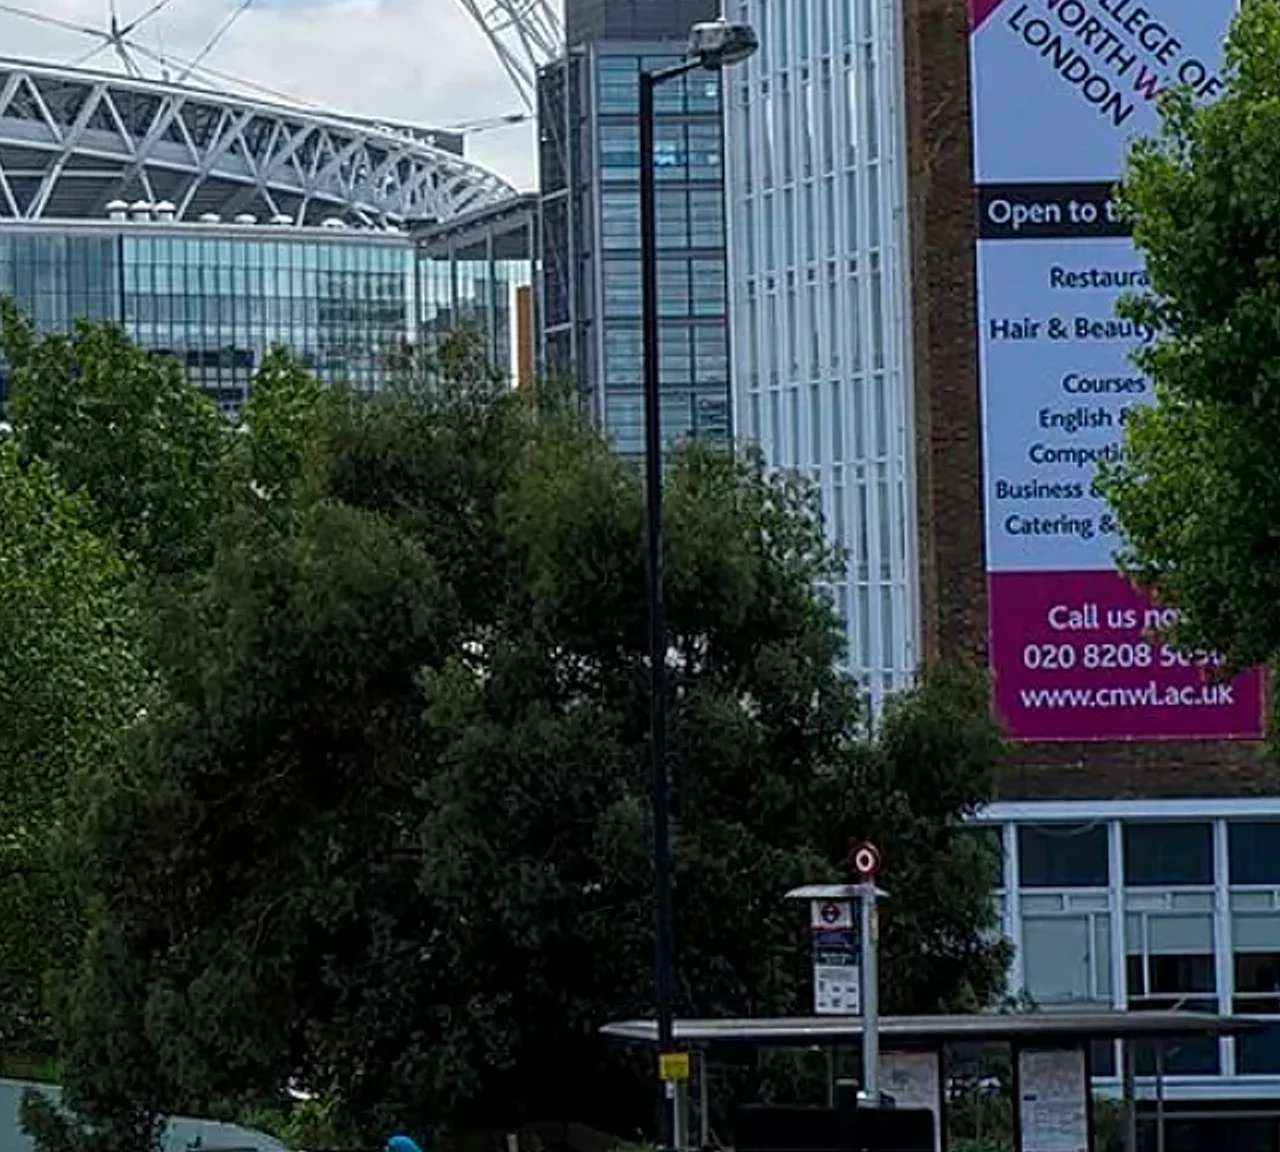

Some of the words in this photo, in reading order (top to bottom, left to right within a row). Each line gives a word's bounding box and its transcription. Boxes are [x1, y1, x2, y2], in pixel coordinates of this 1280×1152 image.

[1007, 5, 1135, 127] LONDON
[1178, 58, 1225, 98] OF
[987, 199, 1062, 229] Open
[1070, 201, 1097, 223] to
[1050, 267, 1151, 288] Restaura
[990, 317, 1040, 340] Hair
[1048, 317, 1068, 340] &
[1075, 317, 1155, 343] Beauty
[1063, 373, 1146, 394] Courses
[1039, 407, 1112, 433] English
[996, 479, 1083, 499] Business
[1006, 513, 1094, 540] Catering
[1098, 513, 1116, 535] &
[1048, 603, 1099, 631] Call
[1107, 611, 1137, 630] us
[1144, 608, 1181, 630] no
[1023, 644, 1076, 669] 020
[1083, 643, 1153, 669] 8208
[1020, 680, 1234, 708] www.cnwl.ac.uk
